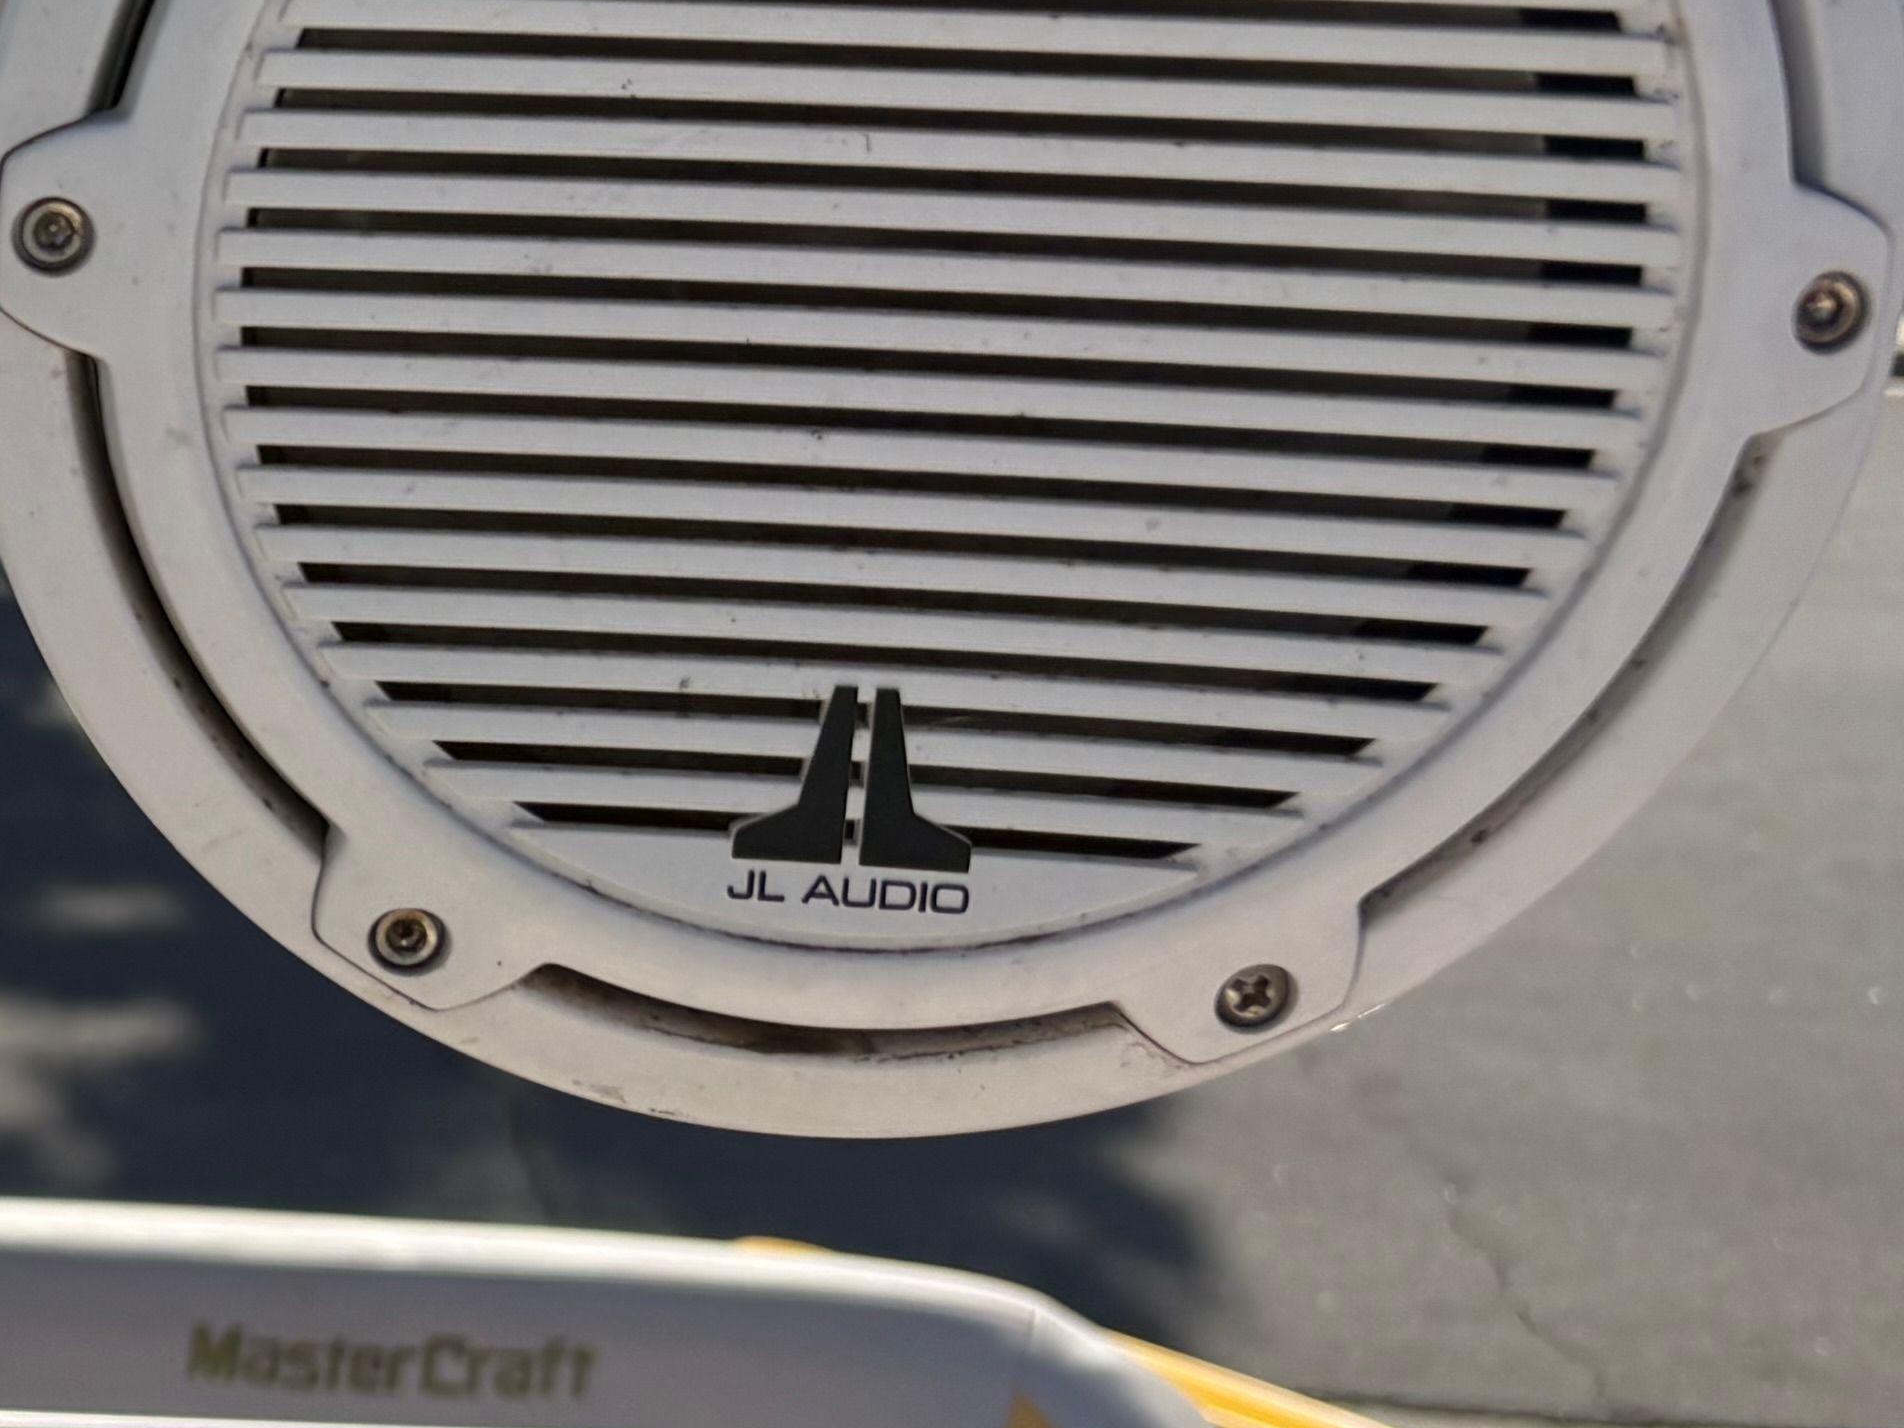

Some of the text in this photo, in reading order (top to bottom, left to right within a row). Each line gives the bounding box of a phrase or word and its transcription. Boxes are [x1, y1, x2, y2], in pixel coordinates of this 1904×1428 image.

[726, 869, 970, 915] JL AUDIO
[187, 1320, 598, 1400] MasterCraft
